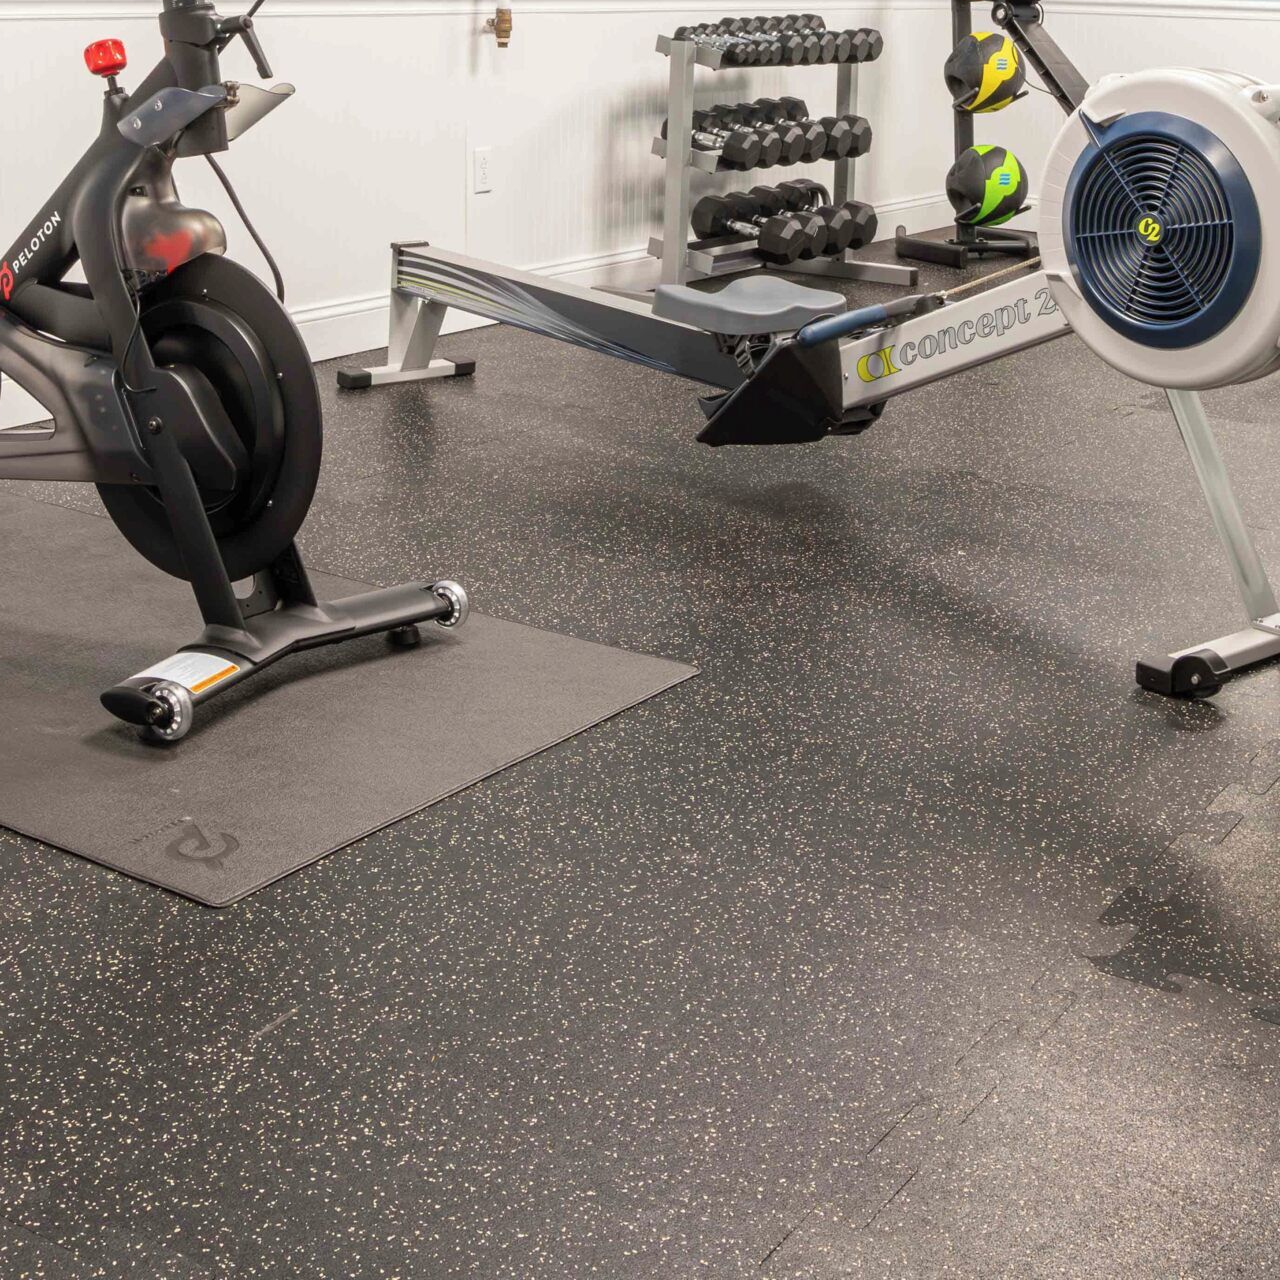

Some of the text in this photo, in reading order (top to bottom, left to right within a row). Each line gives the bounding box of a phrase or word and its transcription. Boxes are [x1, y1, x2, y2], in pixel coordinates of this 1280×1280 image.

[12, 211, 62, 274] PELOTON
[899, 287, 1060, 366] concept 2
